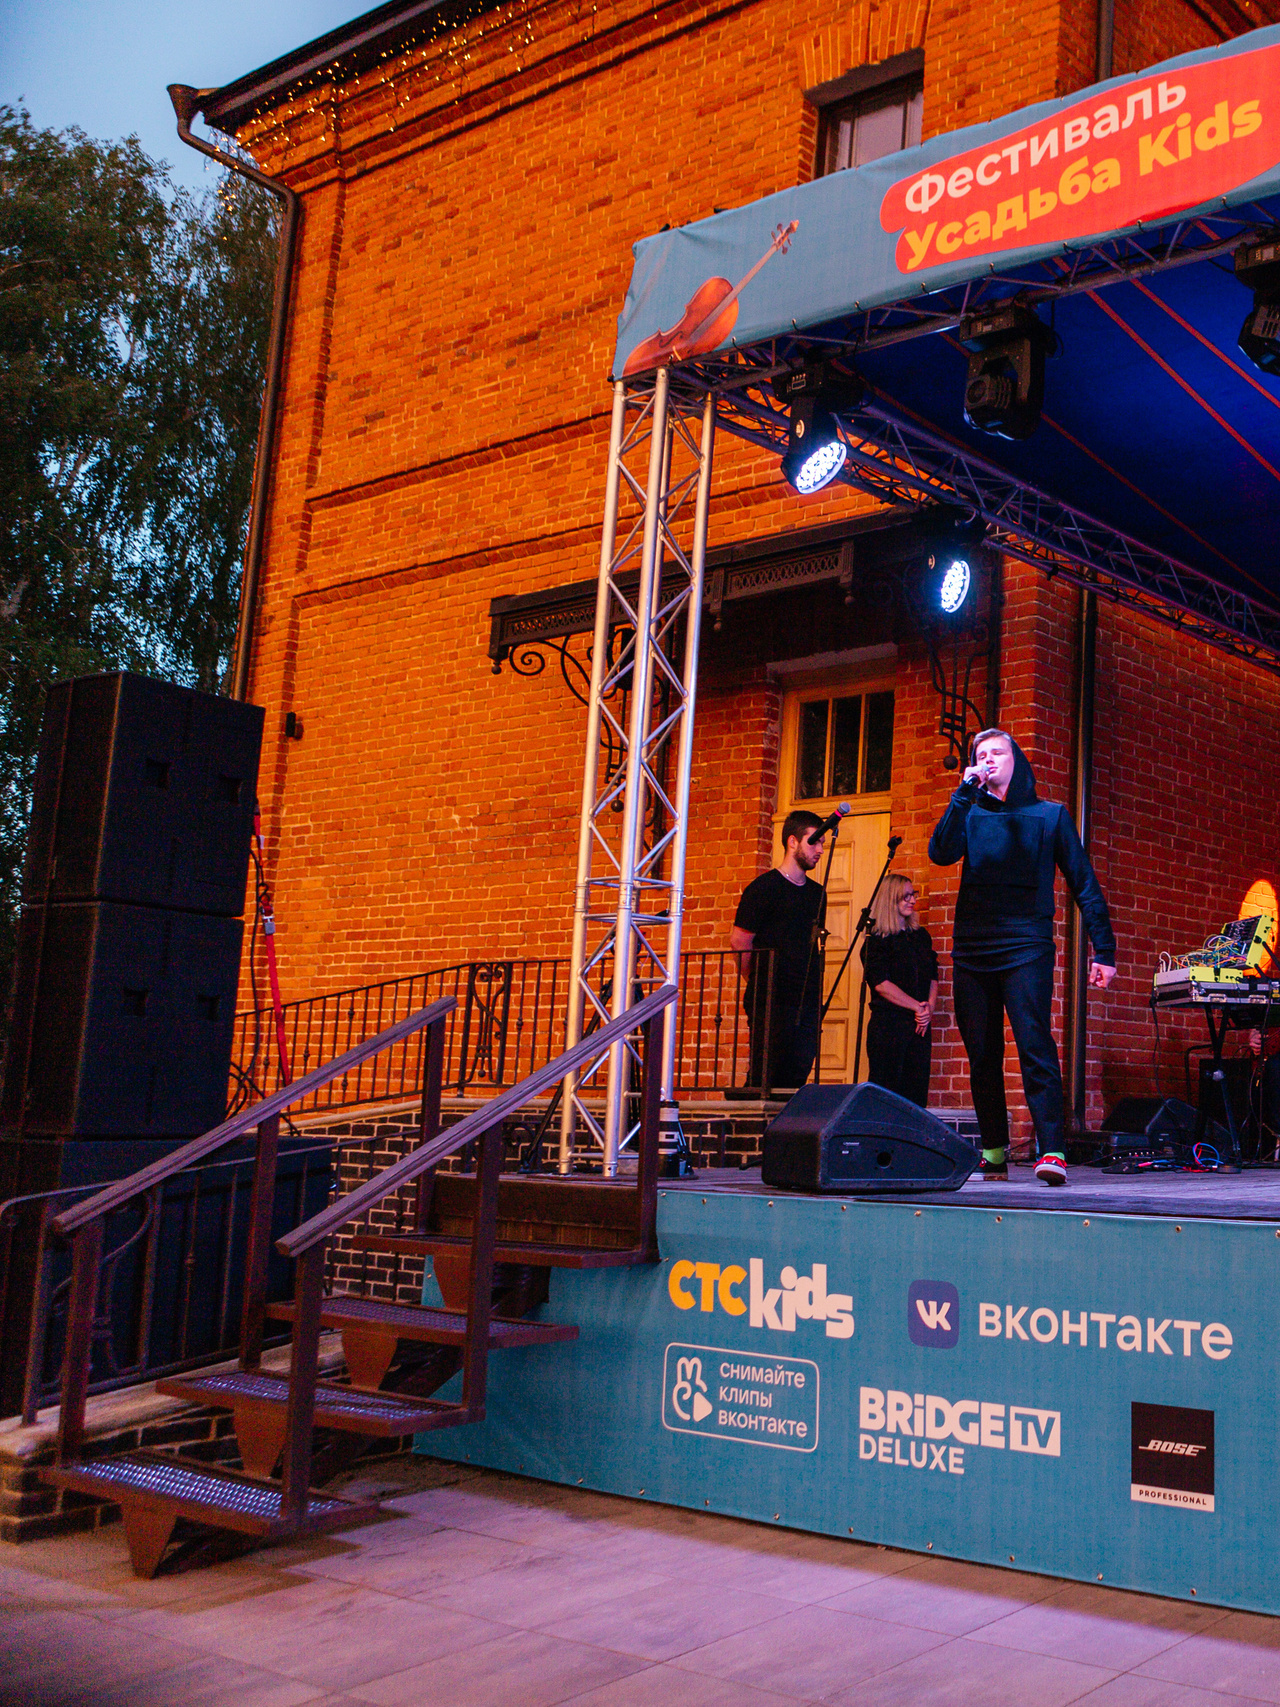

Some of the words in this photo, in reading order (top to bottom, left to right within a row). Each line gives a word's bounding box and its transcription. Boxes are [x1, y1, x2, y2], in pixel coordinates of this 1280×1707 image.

[905, 81, 1187, 214] Фестиваль
[904, 156, 1121, 270] Усадьба
[1138, 100, 1263, 177] Kids
[1014, 1412, 1056, 1449] TV
[1139, 1439, 1206, 1457] BOSE
[859, 1433, 965, 1475] DELUXE
[1139, 1489, 1207, 1506] PROFESSIONAL
